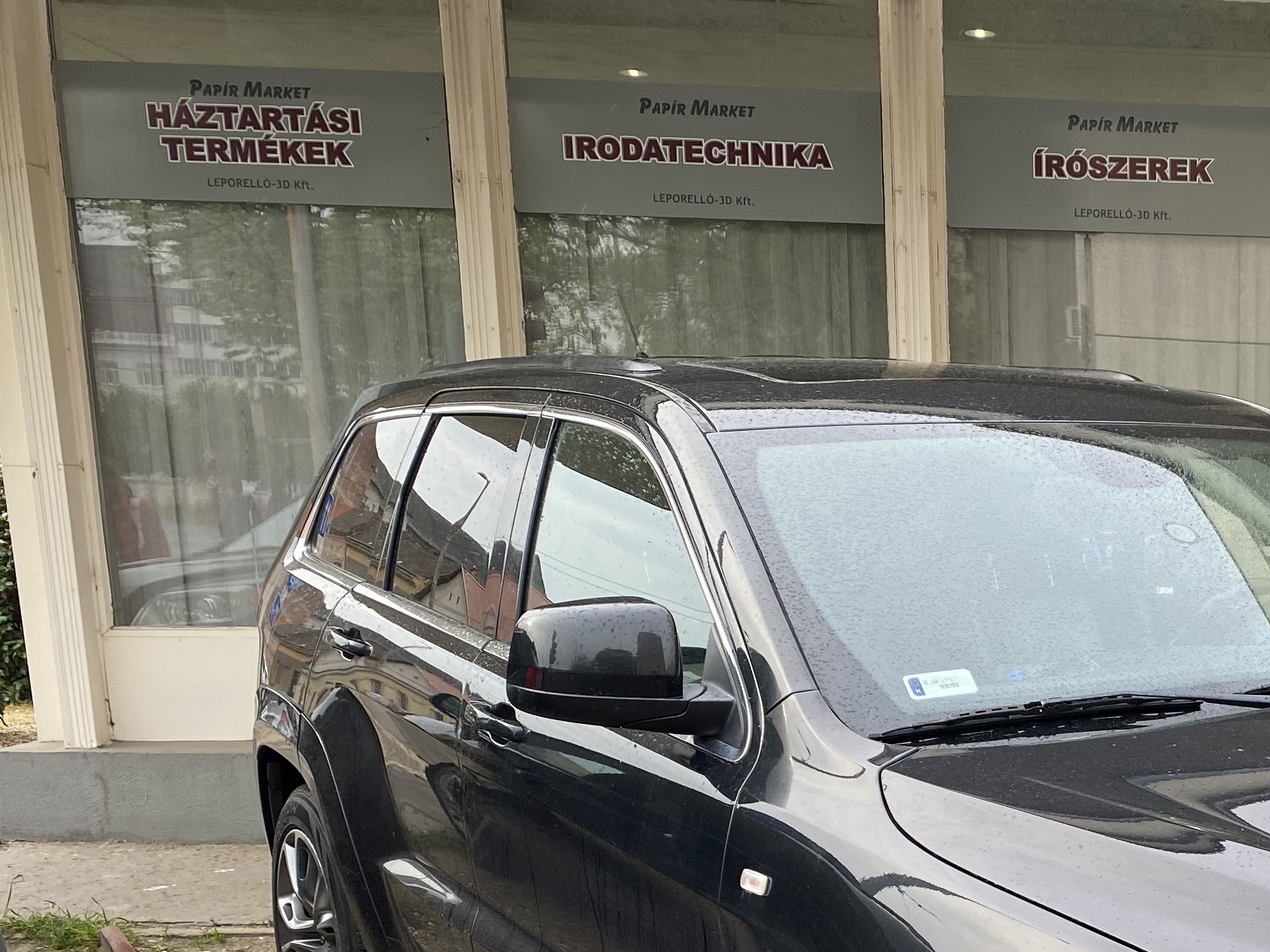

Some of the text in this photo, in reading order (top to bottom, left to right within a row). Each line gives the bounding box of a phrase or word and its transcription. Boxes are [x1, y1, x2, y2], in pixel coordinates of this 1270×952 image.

[243, 81, 311, 99] MARKET
[145, 97, 362, 135] HÁZTARTÁSI
[690, 99, 755, 118] MARKET
[1116, 116, 1179, 134] MARKET
[159, 133, 354, 168] TERMÉKEK
[562, 134, 833, 170] IRODATECHNIKA
[1033, 147, 1214, 184] ÍRÓSZEREK
[207, 177, 314, 190] LEPORELLÓ-3D Kft.
[653, 192, 755, 206] LEPORELLÓ-3D Kft.
[1074, 208, 1172, 221] LEPORELLÓ-3D Kft.
